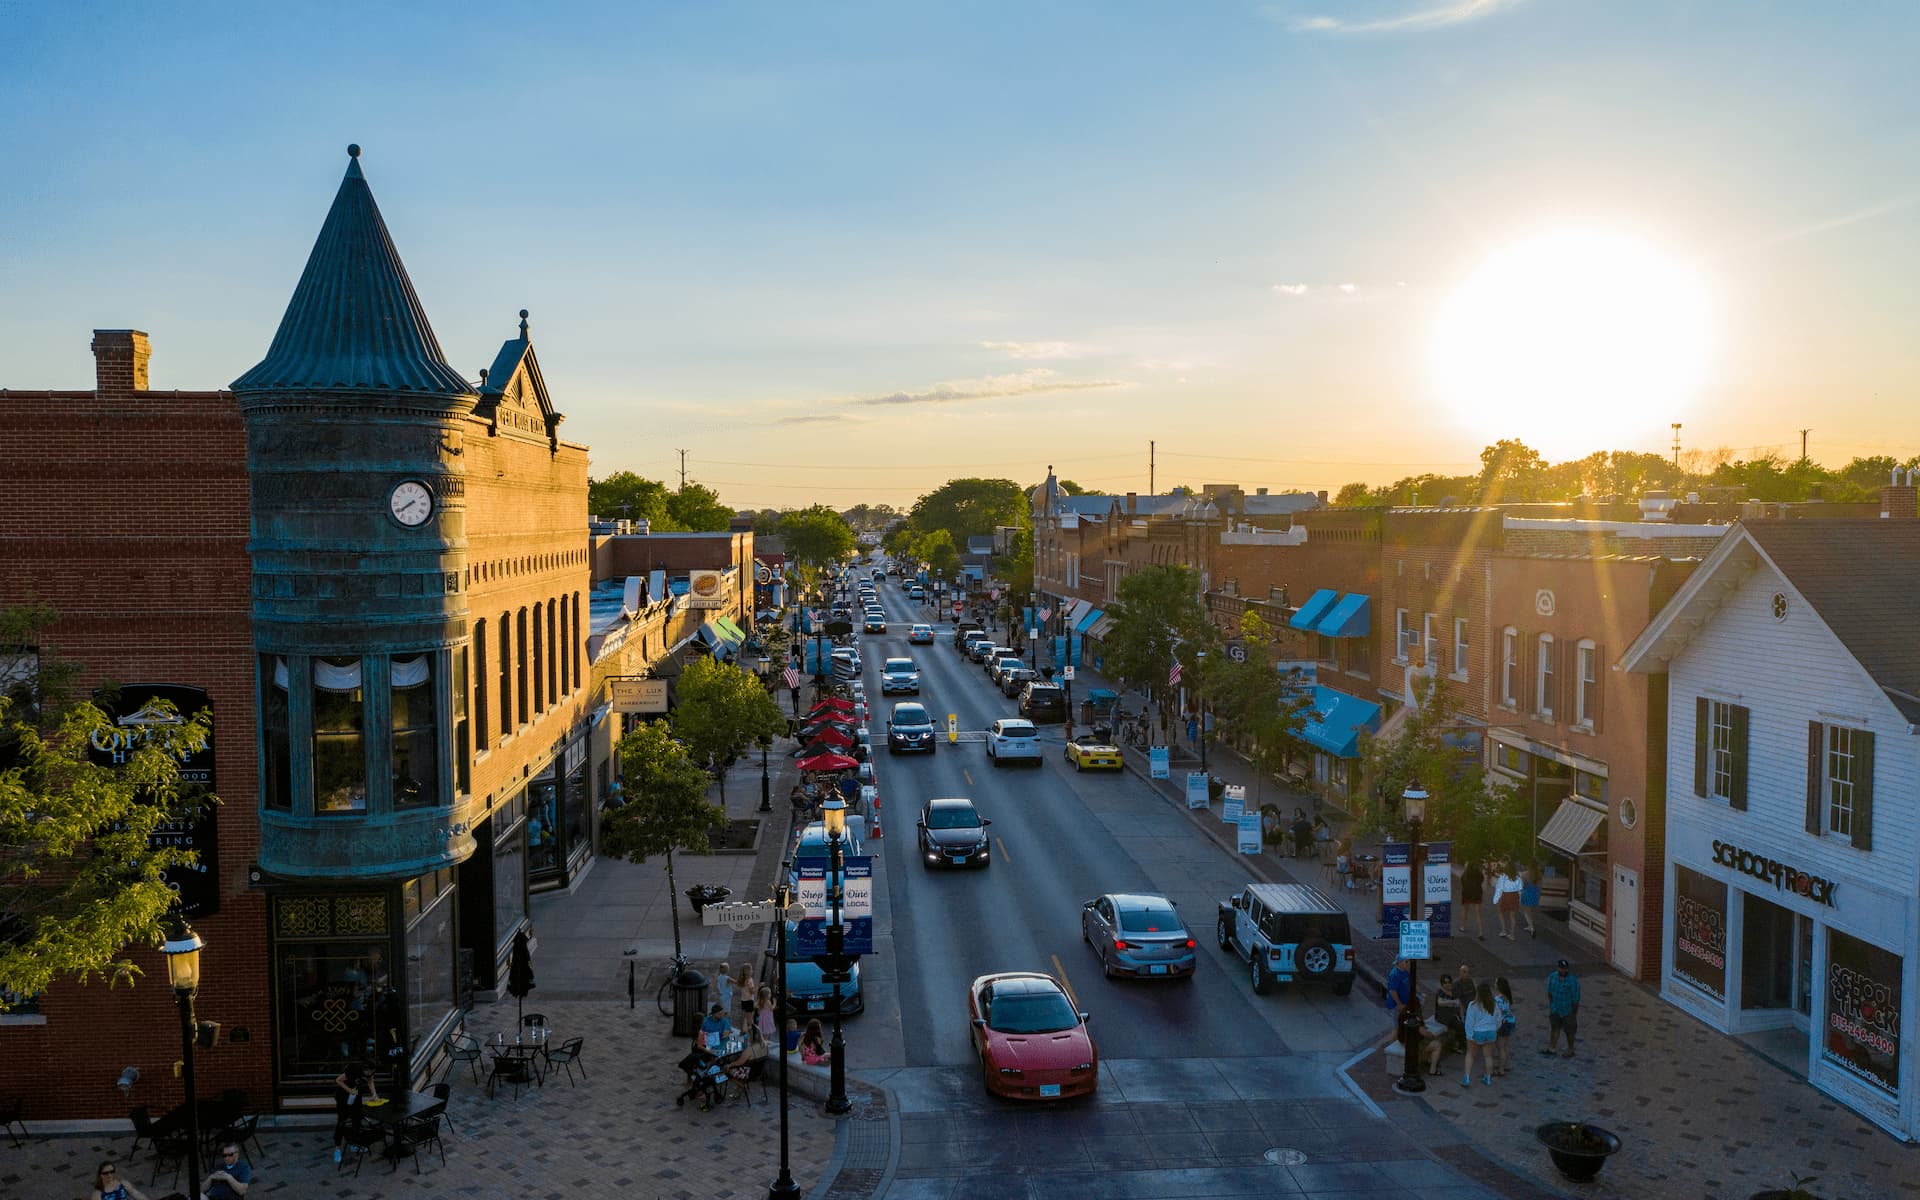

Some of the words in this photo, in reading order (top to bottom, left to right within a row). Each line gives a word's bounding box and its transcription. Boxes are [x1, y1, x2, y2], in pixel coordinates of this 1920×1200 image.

[1427, 875, 1449, 885] Dine
[1712, 839, 1772, 884] SCHOOL
[1784, 863, 1837, 909] ROCK
[1386, 876, 1408, 888] Shop
[801, 889, 823, 902] Shop
[846, 889, 868, 899] Dine
[719, 911, 760, 922] Illinois
[1402, 923, 1409, 934] 3
[1831, 962, 1891, 1006] SCHOOL
[1850, 996, 1898, 1038] ROCK
[1831, 1012, 1895, 1056] 815-246-3400
